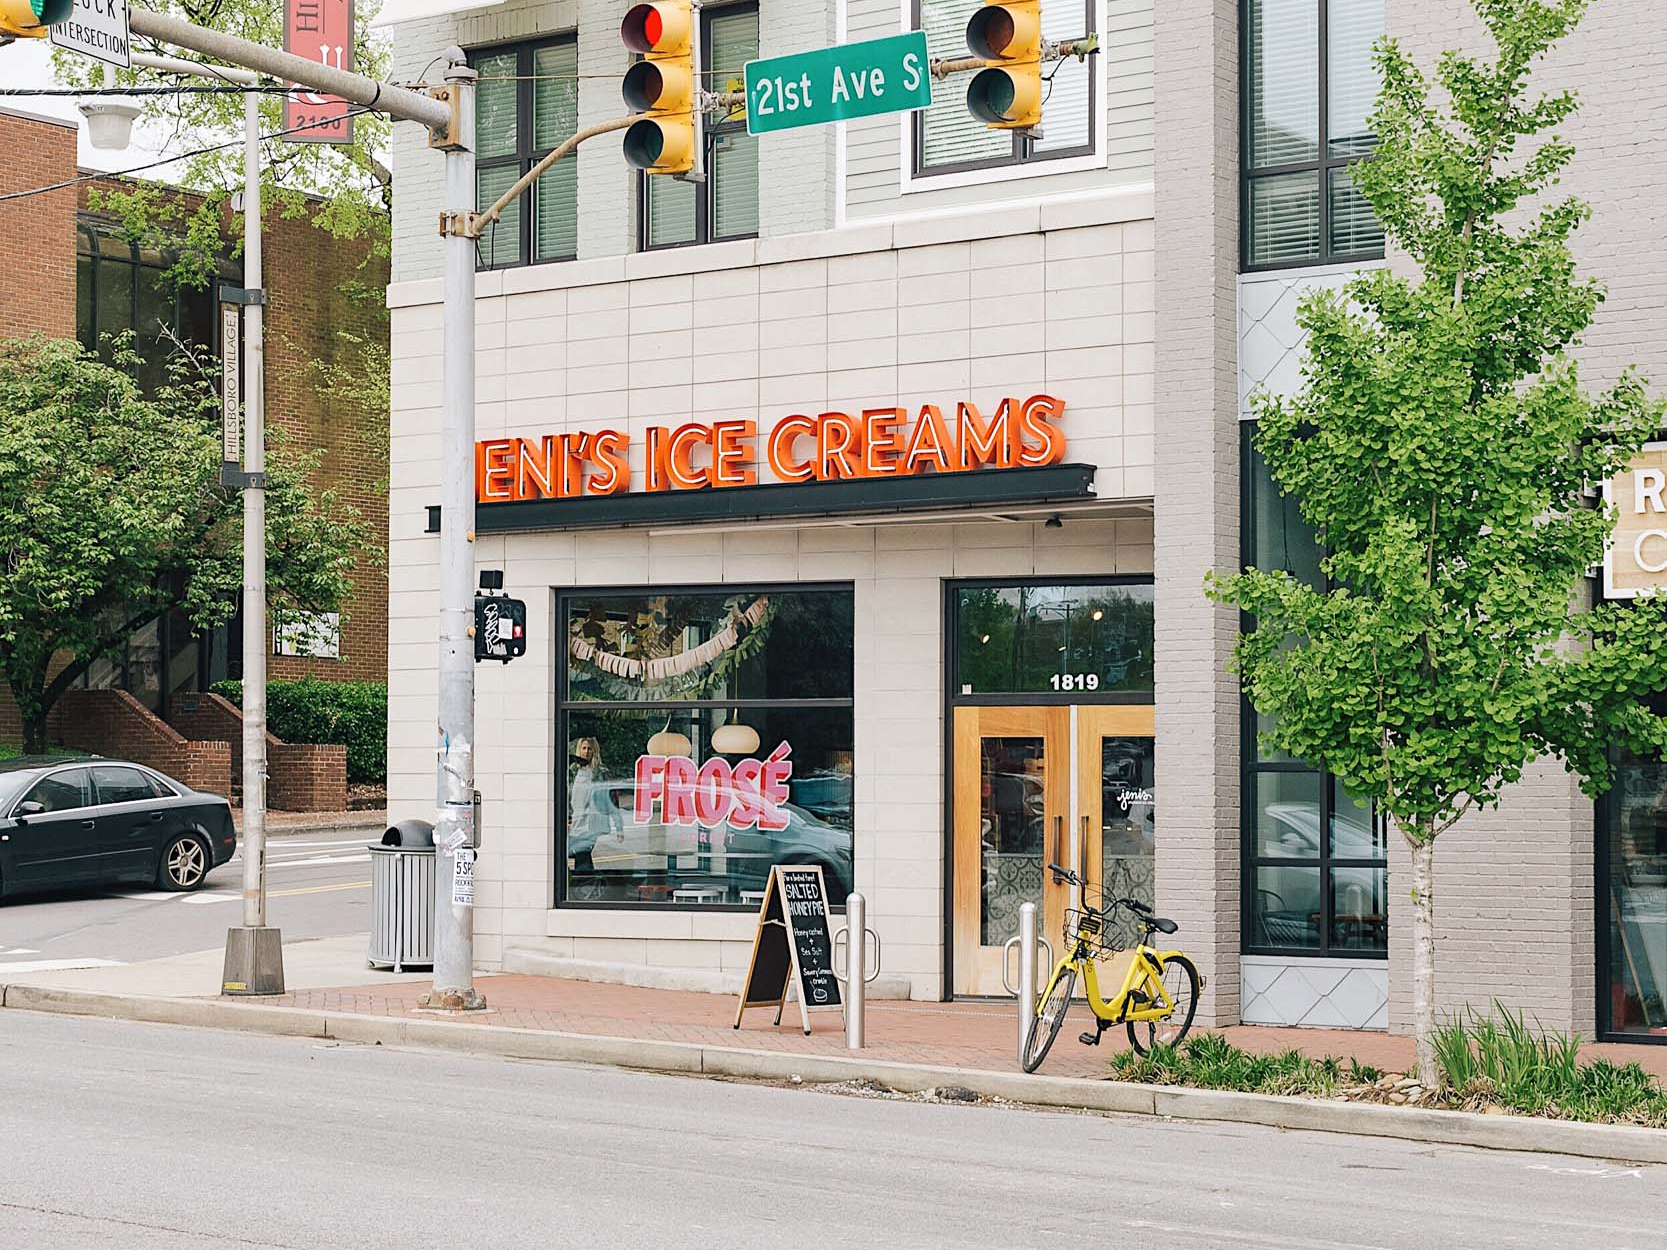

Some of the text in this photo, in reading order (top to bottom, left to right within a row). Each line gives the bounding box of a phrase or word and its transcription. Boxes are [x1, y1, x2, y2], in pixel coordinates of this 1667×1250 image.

[756, 53, 920, 116] 21st Ave S
[226, 319, 237, 455] HILLSBORO VILLAGE
[475, 394, 1067, 503] ENI'S ICE CREAMS
[1050, 674, 1099, 690] 1819
[634, 739, 792, 831] FROSÉ
[456, 861, 462, 875] 5
[785, 883, 819, 899] SALTED
[787, 900, 825, 917] HONEY PIE
